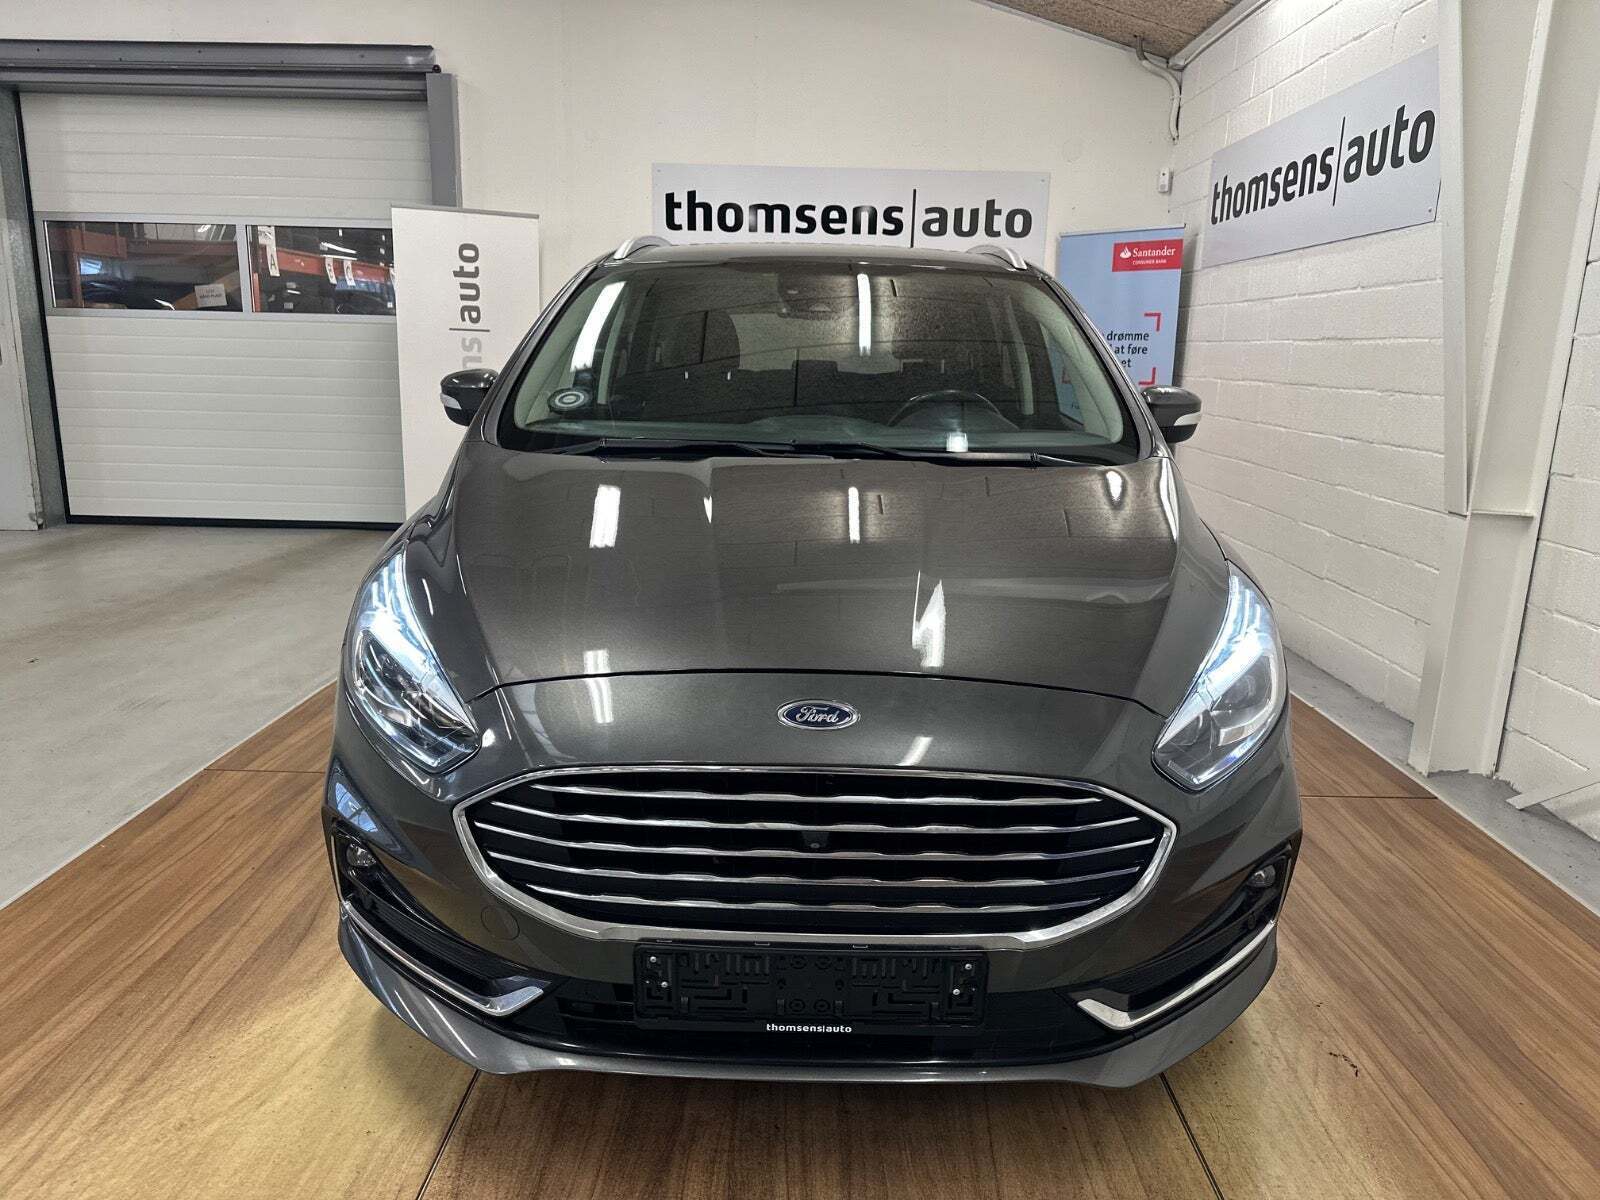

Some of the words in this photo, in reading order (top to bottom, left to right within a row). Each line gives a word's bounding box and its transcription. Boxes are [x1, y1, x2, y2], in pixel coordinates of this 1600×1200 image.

[1210, 146, 1335, 225] thomsens
[1343, 104, 1436, 184] auto
[664, 190, 904, 236] thomsens
[921, 199, 1033, 239] auto
[1132, 245, 1176, 257] Santander
[452, 242, 481, 324] auto
[1106, 331, 1150, 341] drømme
[1114, 345, 1125, 354] at
[1127, 344, 1148, 355] føre
[796, 706, 840, 723] Ford
